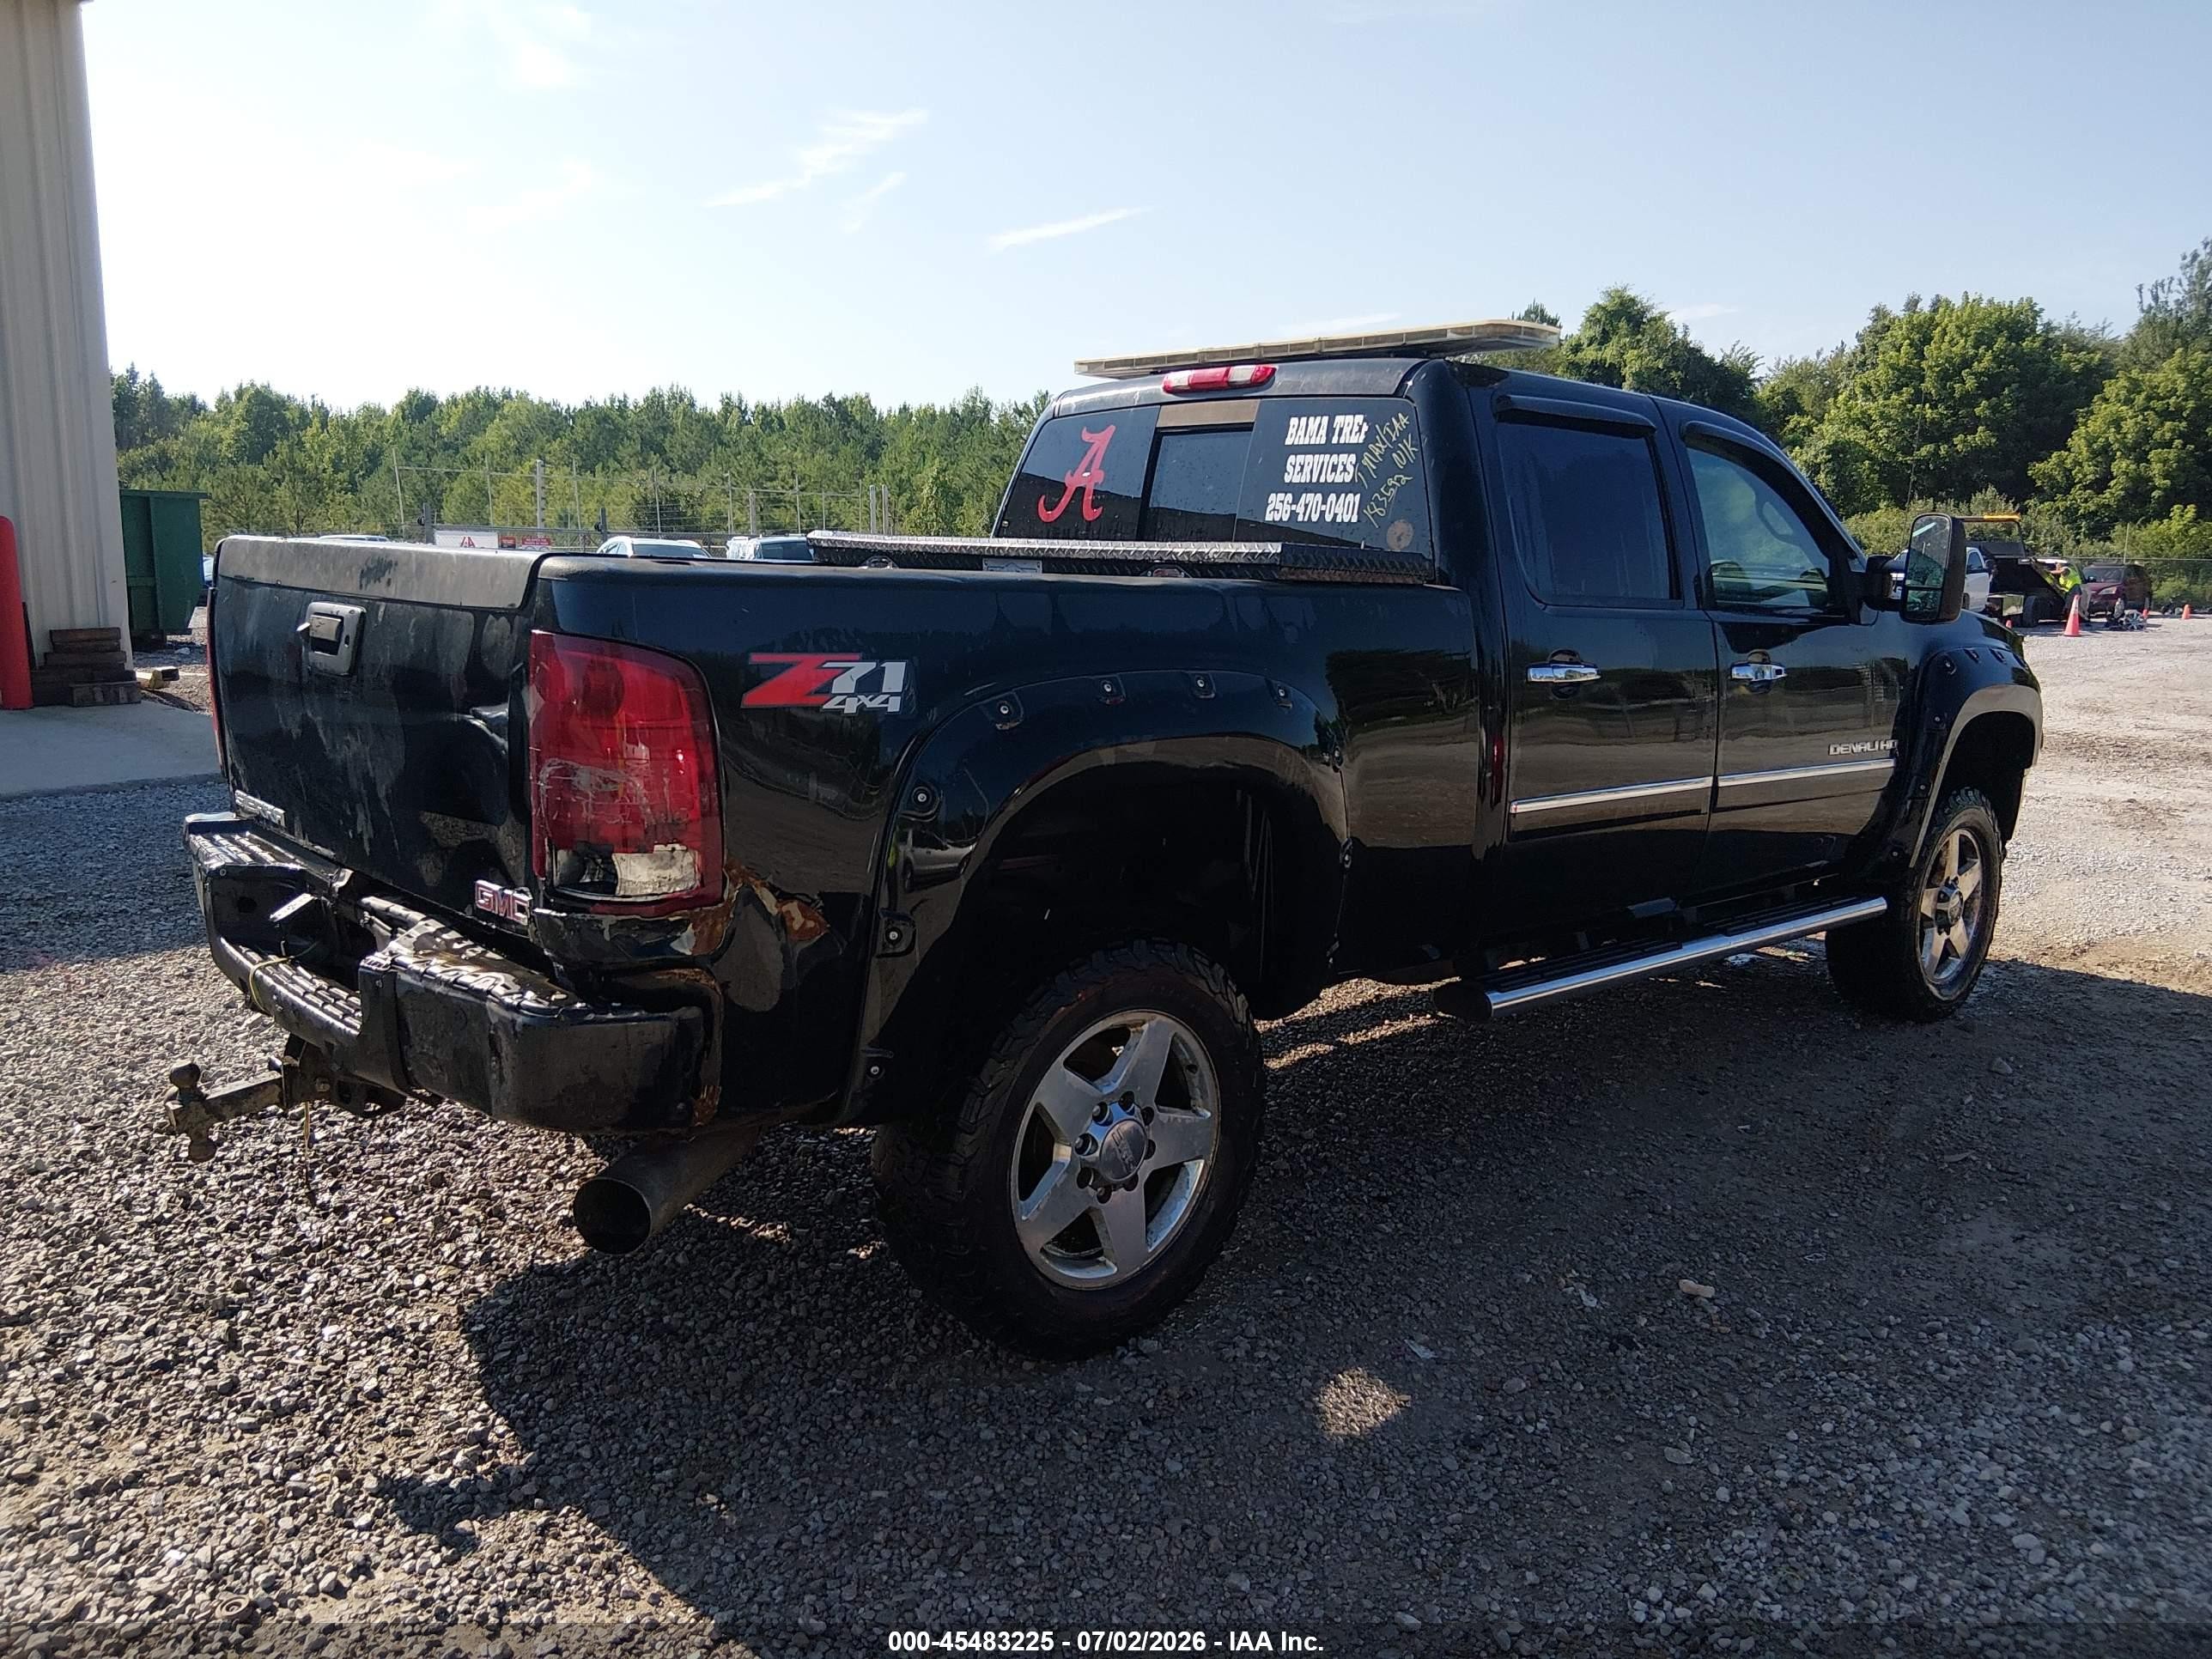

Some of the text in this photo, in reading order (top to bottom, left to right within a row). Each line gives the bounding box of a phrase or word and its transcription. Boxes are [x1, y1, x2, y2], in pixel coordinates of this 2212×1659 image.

[1285, 416, 1329, 446] BAMA
[1037, 424, 1116, 522] A
[1284, 453, 1357, 483] SERVICES
[1265, 493, 1361, 523] 256-470-0401
[1363, 474, 1413, 528] 183592
[742, 653, 906, 707] Z71
[1829, 739, 1879, 756] DENALI
[475, 879, 532, 926] GMC
